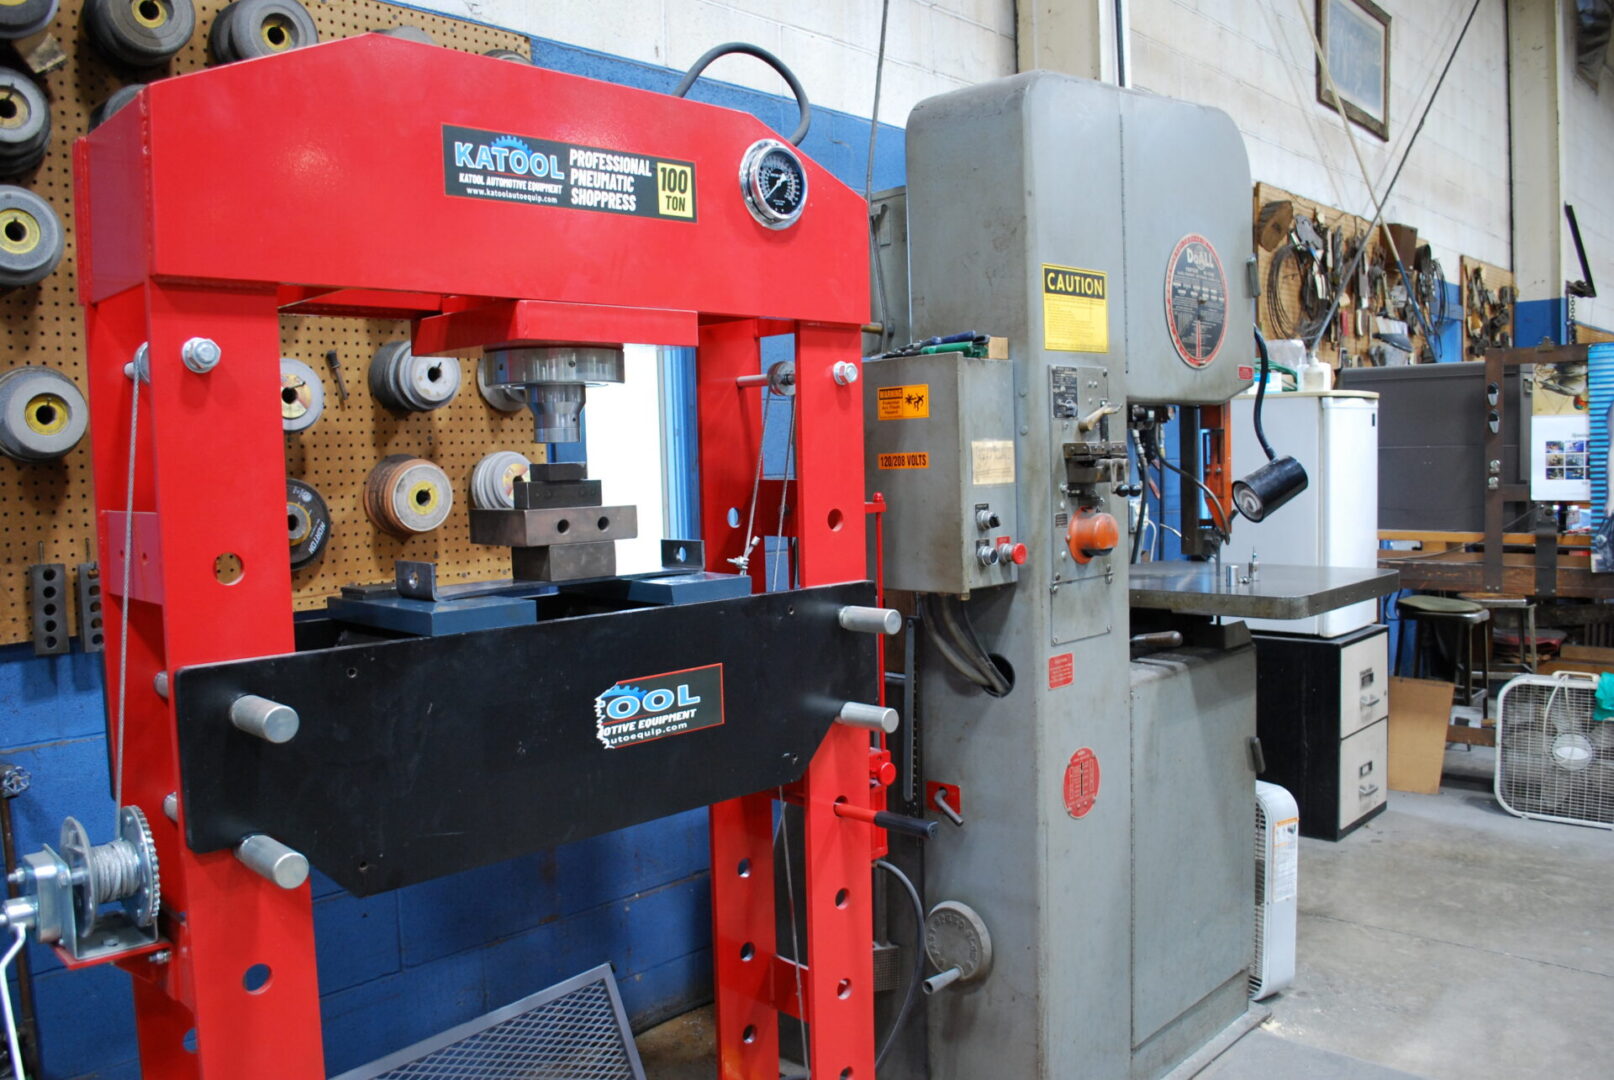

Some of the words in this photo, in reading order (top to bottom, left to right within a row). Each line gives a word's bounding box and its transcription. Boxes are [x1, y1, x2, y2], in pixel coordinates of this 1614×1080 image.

[455, 141, 565, 180] KATOOL
[569, 148, 652, 177] PROFESSIONAL
[459, 173, 485, 185] KATOOL
[486, 176, 527, 190] AUTOMOTIVE
[528, 181, 563, 194] EQUIPMENT
[570, 168, 635, 192] PNEUMATIC
[660, 167, 688, 194] 100
[466, 187, 557, 203] www.katoolautoequip.com
[571, 187, 637, 212] SHOPPRESS
[666, 195, 686, 212] TON
[1047, 272, 1103, 296] CAUTION
[880, 455, 905, 467] 120/208
[907, 454, 927, 467] VOLTS
[308, 521, 326, 554] NORTON
[602, 684, 701, 719] OOL
[602, 721, 636, 737] OTIVE
[638, 708, 697, 729] EQUIPMENT
[610, 721, 688, 744] utoequip.com
